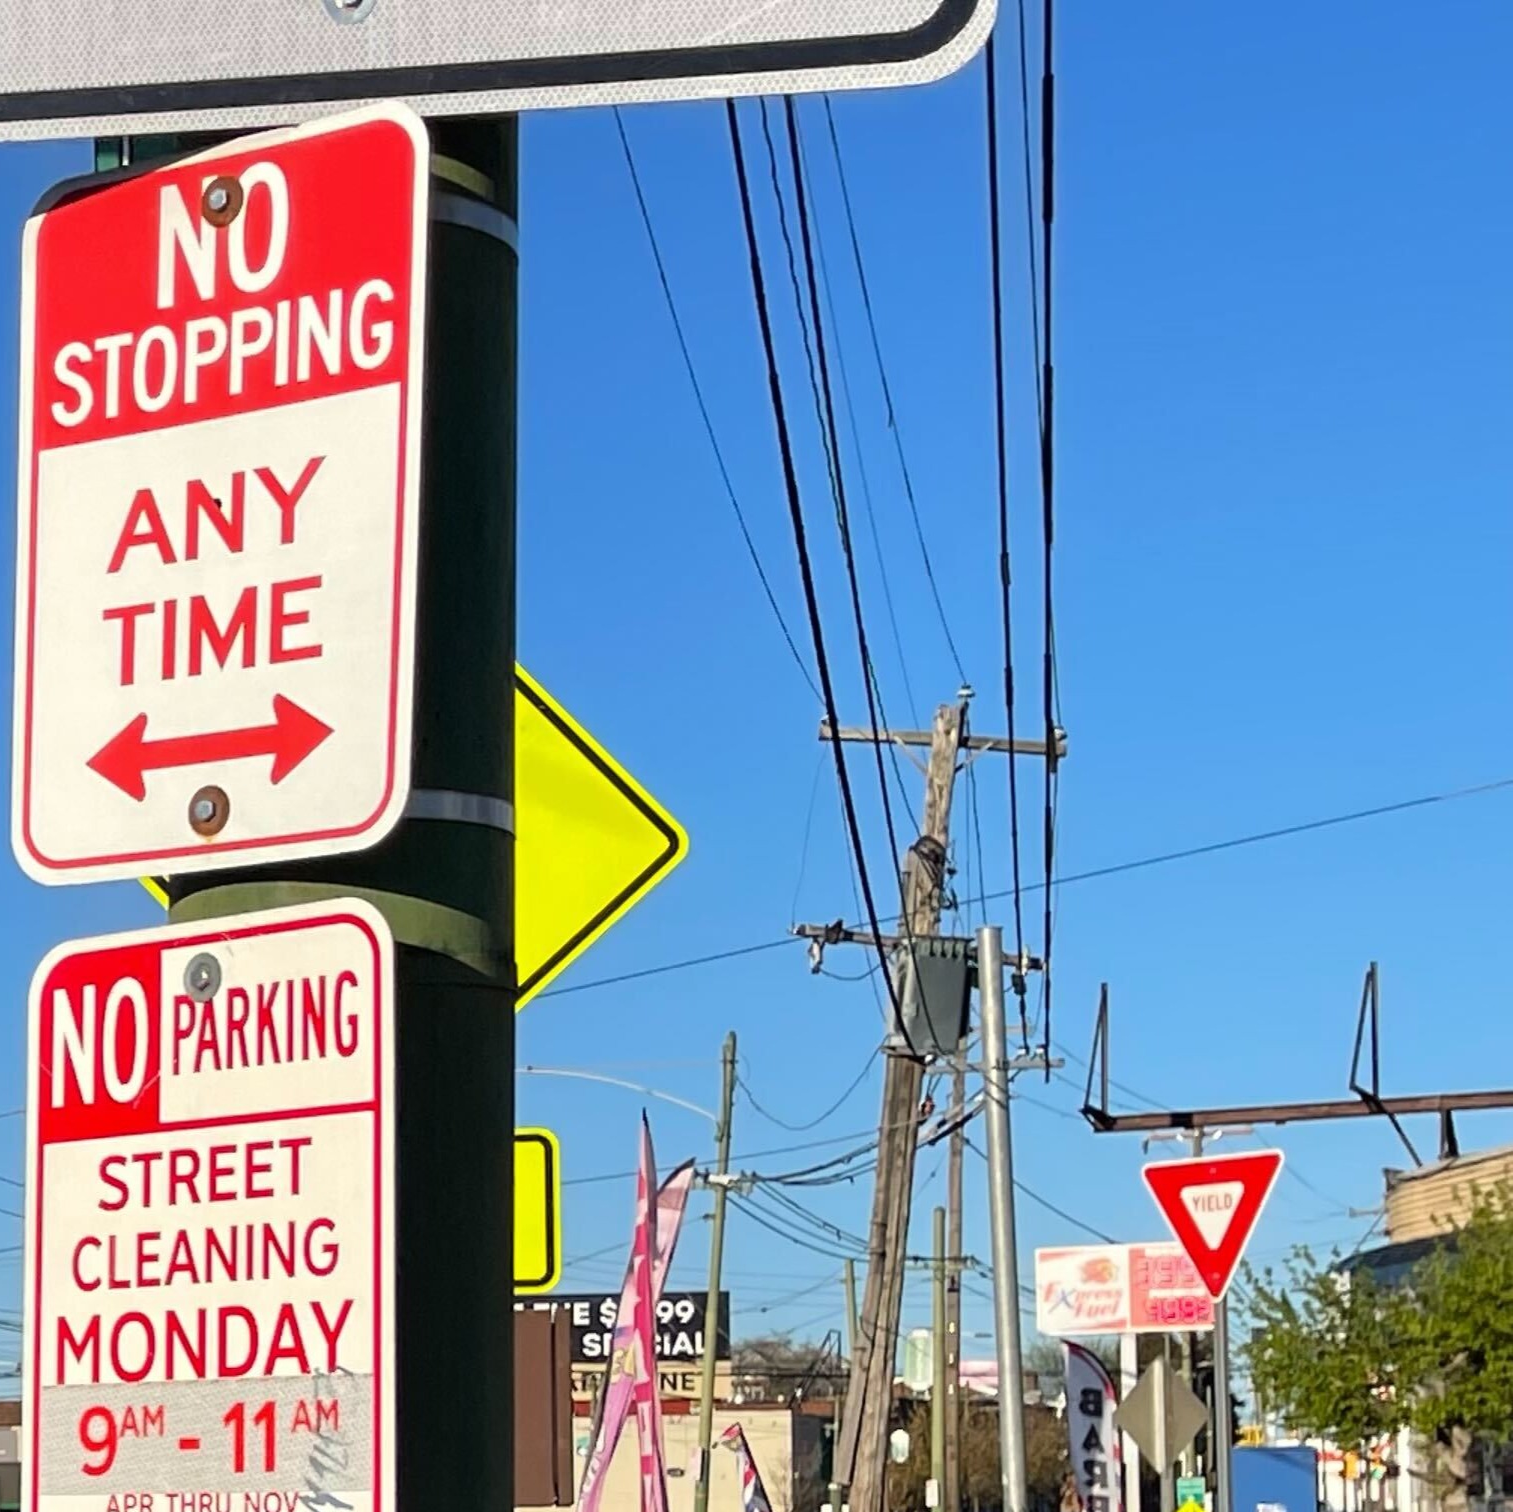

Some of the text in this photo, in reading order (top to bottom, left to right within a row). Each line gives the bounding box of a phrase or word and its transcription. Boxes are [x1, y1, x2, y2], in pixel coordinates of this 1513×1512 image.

[157, 161, 290, 310] NO
[51, 278, 395, 428] STOPPING
[106, 456, 327, 574] ANY
[103, 575, 323, 686] TIME
[51, 976, 149, 1109] NO
[172, 970, 359, 1076] PARKING
[98, 1137, 312, 1212] STREET
[1192, 1193, 1234, 1212] YIELD
[72, 1217, 340, 1292] CLEANING
[57, 1299, 355, 1385] MONDAY
